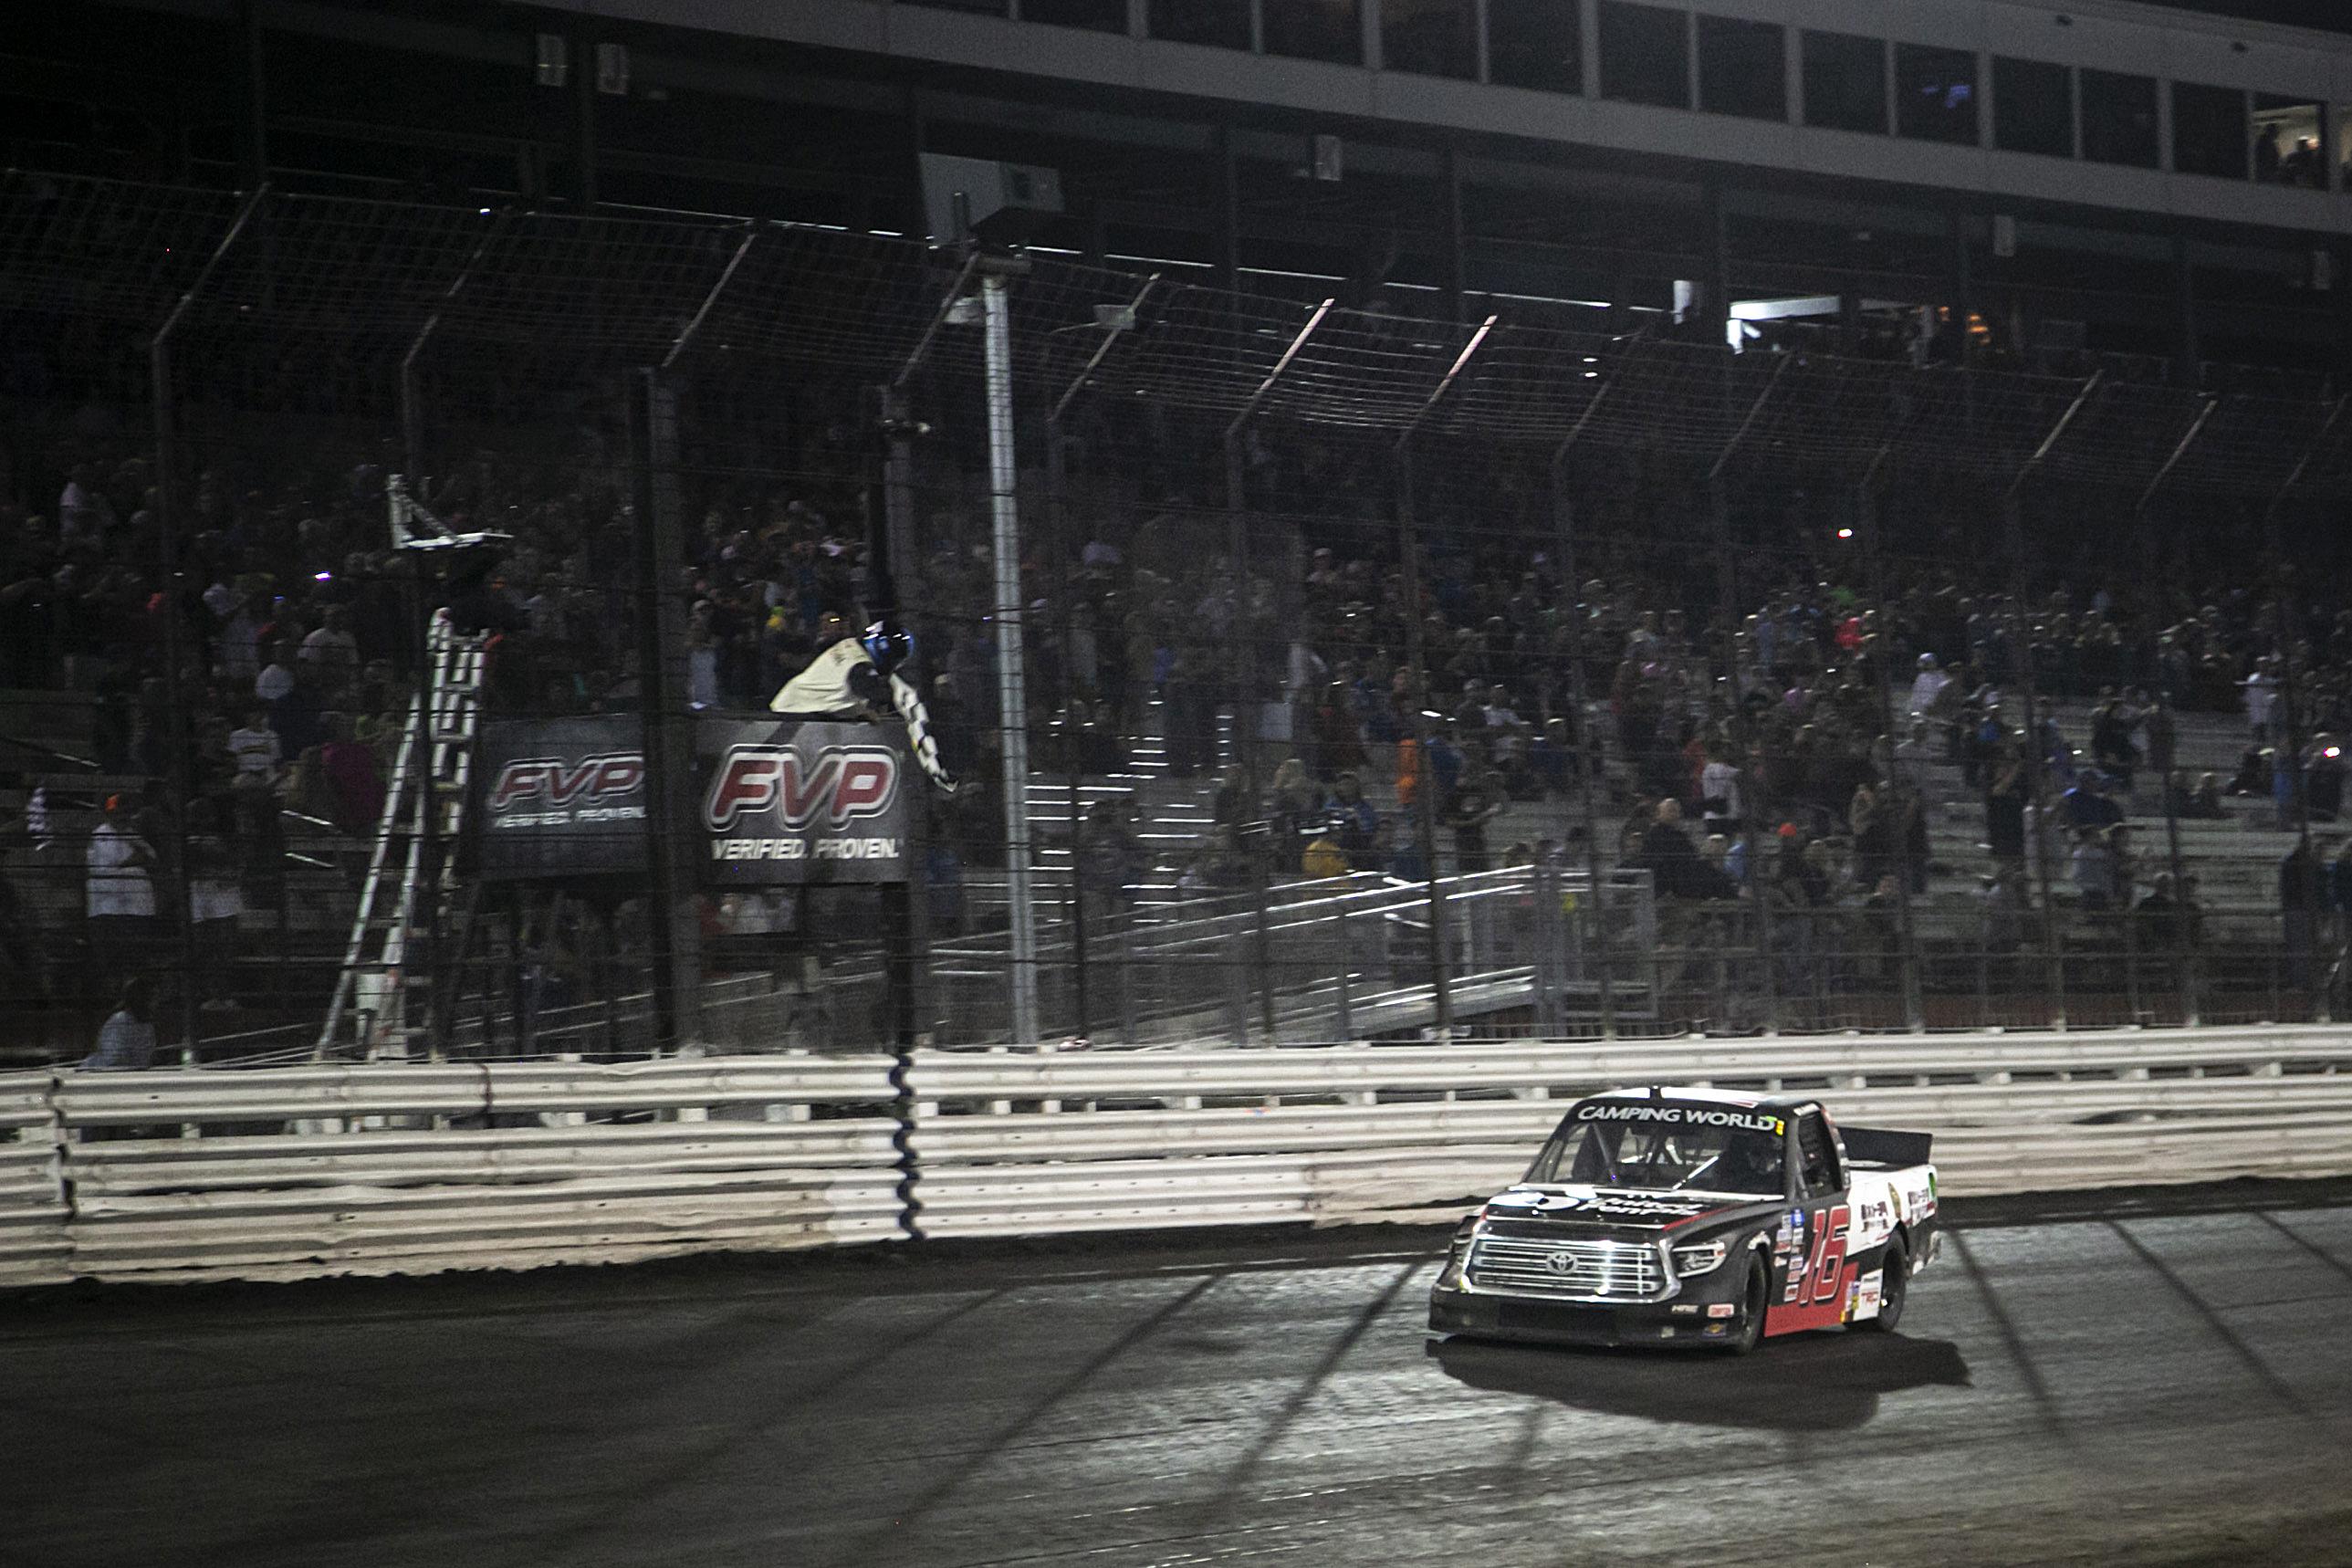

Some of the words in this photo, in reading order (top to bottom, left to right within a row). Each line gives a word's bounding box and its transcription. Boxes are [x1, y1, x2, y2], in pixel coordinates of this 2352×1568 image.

[489, 750, 645, 811] FVP
[706, 743, 899, 831] FVP
[812, 837, 899, 860] PROVEN.
[1577, 1106, 1681, 1123] CAMPING
[1686, 1109, 1775, 1132] WORLD
[1798, 1205, 1850, 1305] 16
